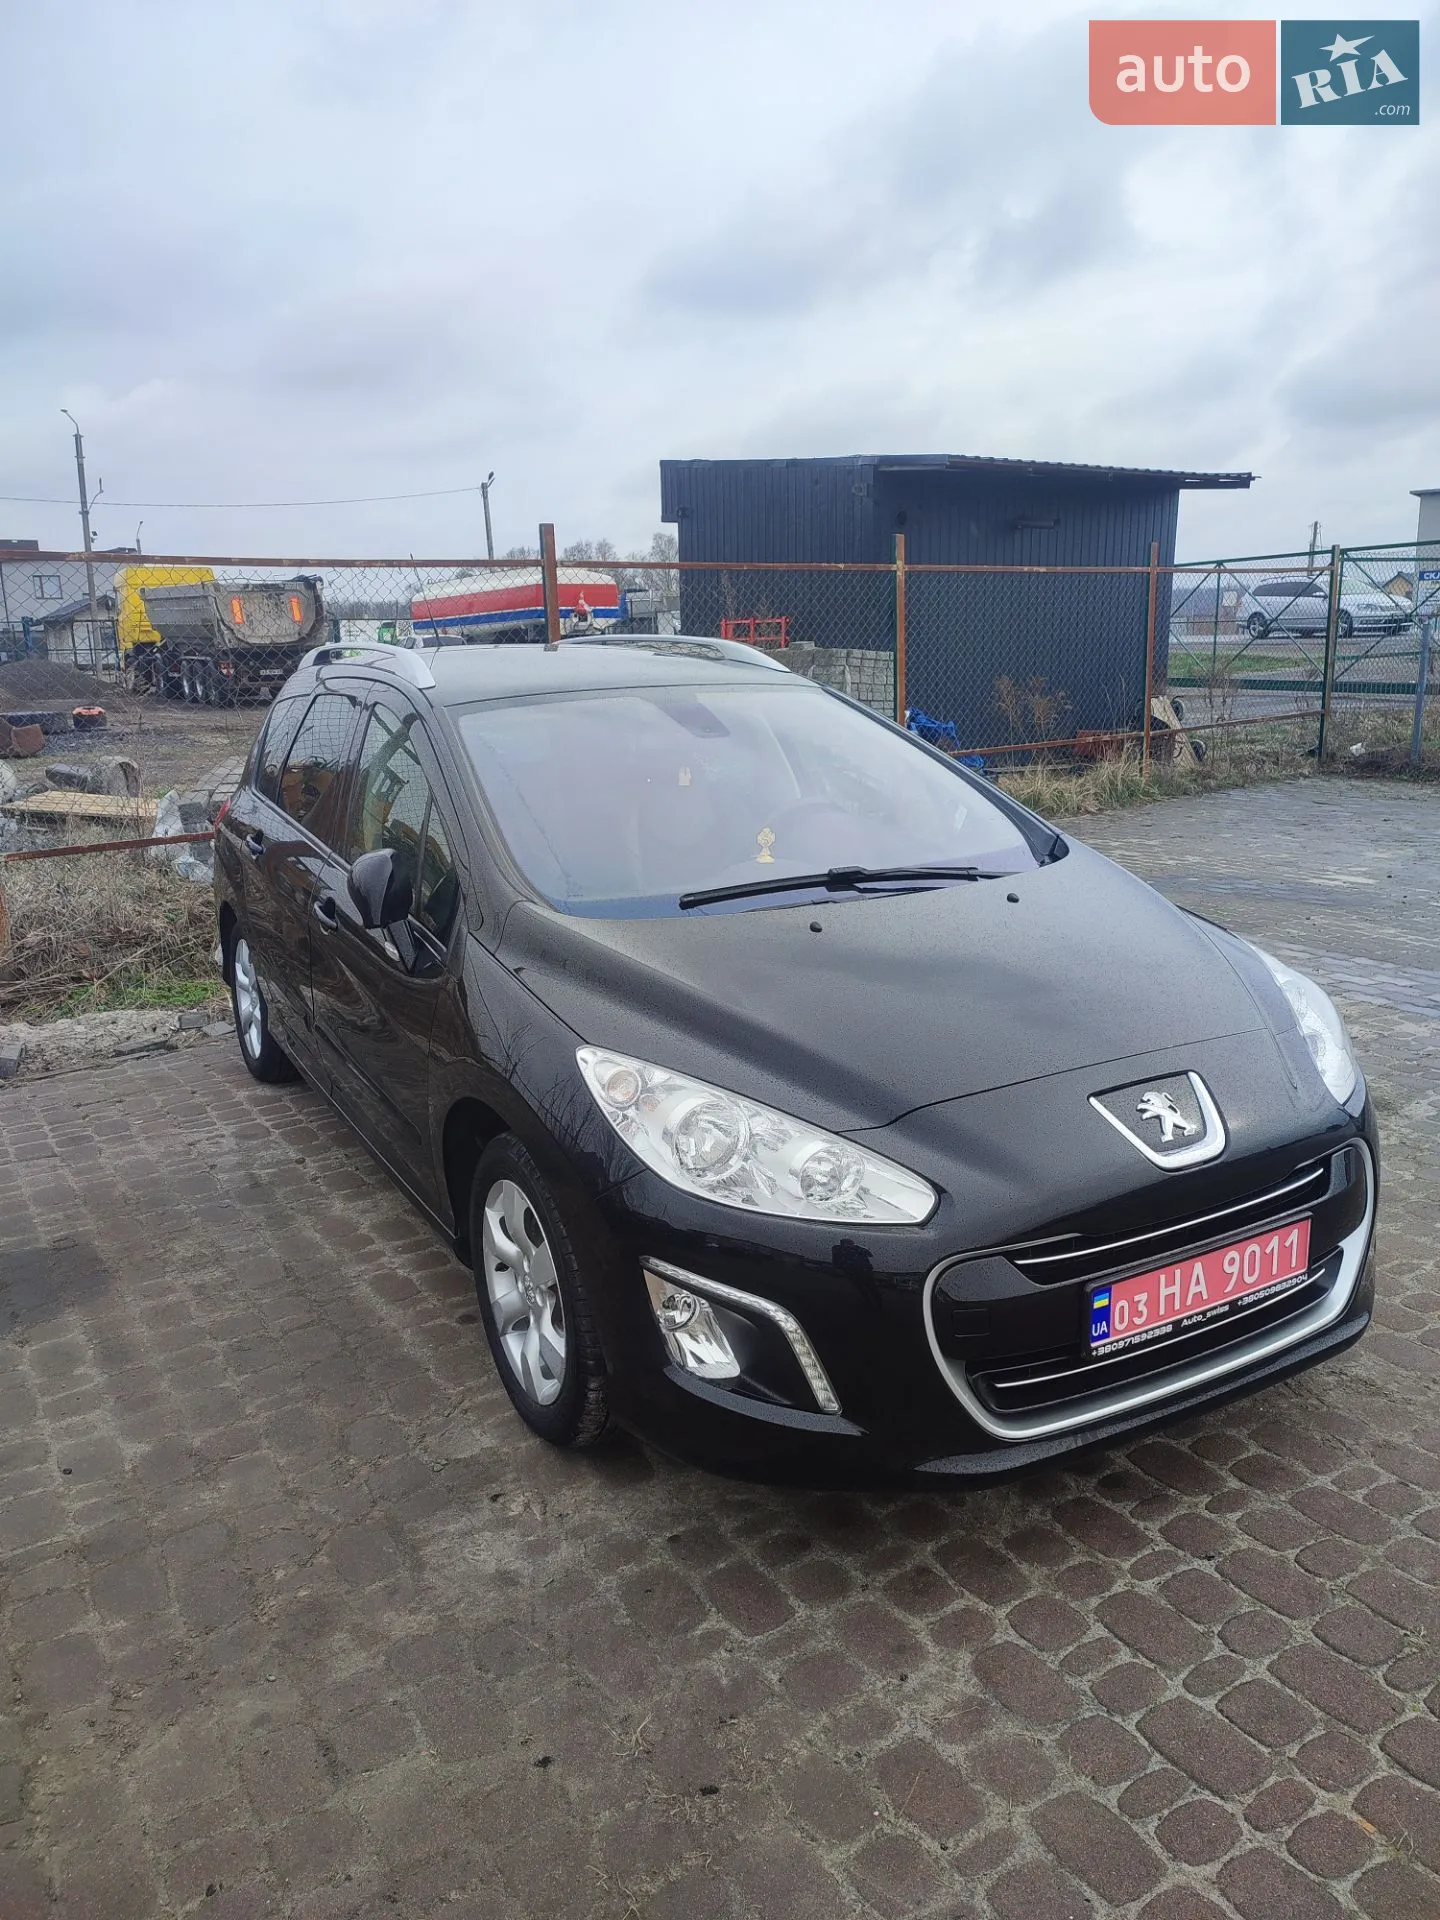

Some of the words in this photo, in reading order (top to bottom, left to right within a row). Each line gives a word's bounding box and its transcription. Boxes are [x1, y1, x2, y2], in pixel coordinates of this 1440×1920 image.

[1114, 1292, 1148, 1331] 03
[1159, 1262, 1209, 1316] HA
[1223, 1228, 1300, 1293] 9011
[1092, 1322, 1108, 1337] UA
